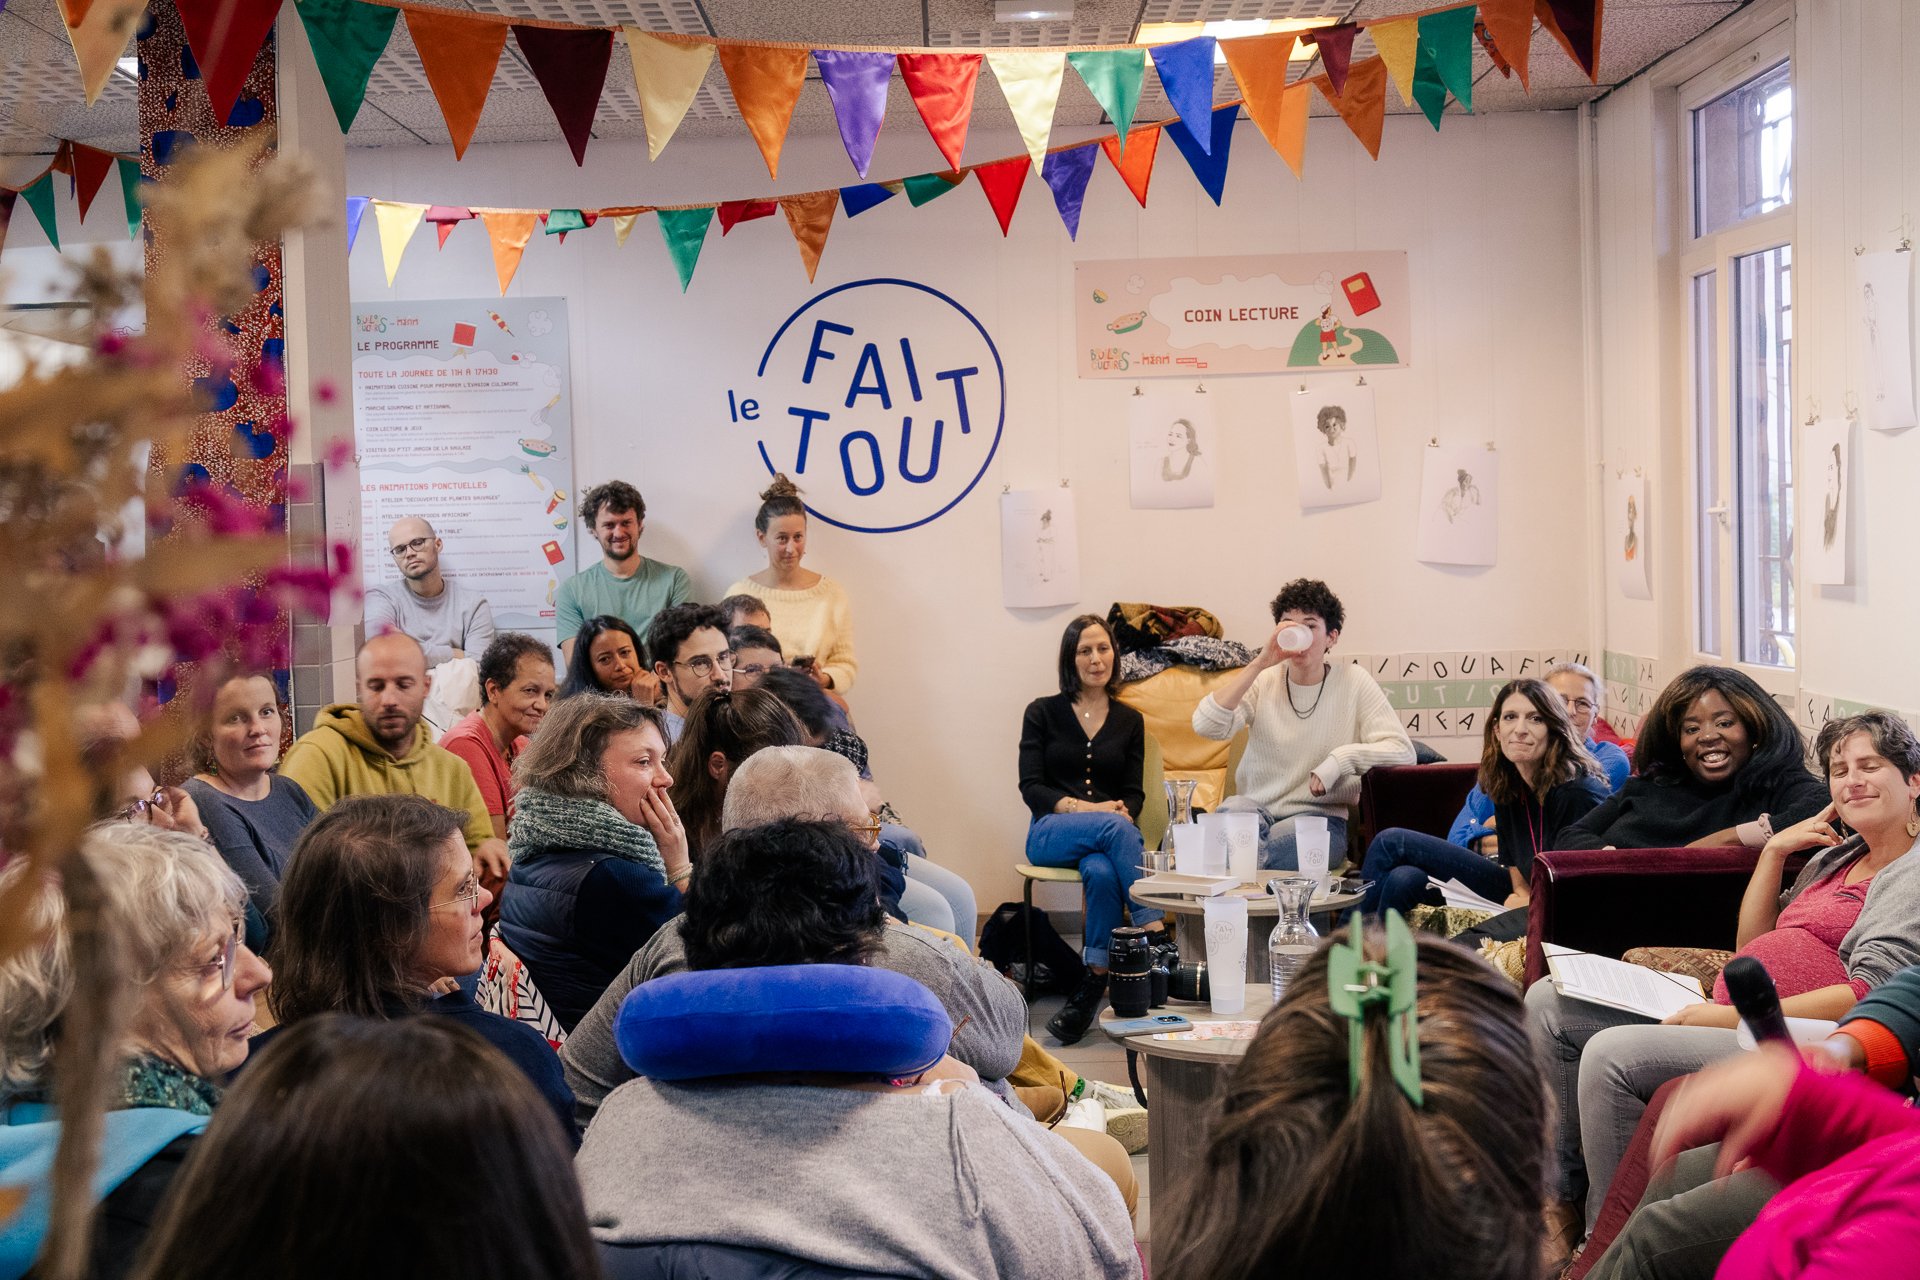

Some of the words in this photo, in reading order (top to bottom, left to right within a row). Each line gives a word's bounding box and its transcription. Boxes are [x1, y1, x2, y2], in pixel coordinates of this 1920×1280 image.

[1184, 308, 1222, 323] COIN
[1228, 306, 1299, 321] LECTURE
[357, 342, 371, 351] LE
[374, 340, 439, 351] PROGRAMME
[358, 370, 383, 379] TOUTE
[386, 370, 397, 379] LA
[437, 369, 448, 377] DE
[451, 368, 463, 376] 11H
[475, 367, 498, 376] 17H30
[727, 389, 760, 423] le
[361, 483, 376, 492] LES
[379, 482, 429, 491] ANIMATIONS
[431, 481, 488, 491] PONCTUELLES
